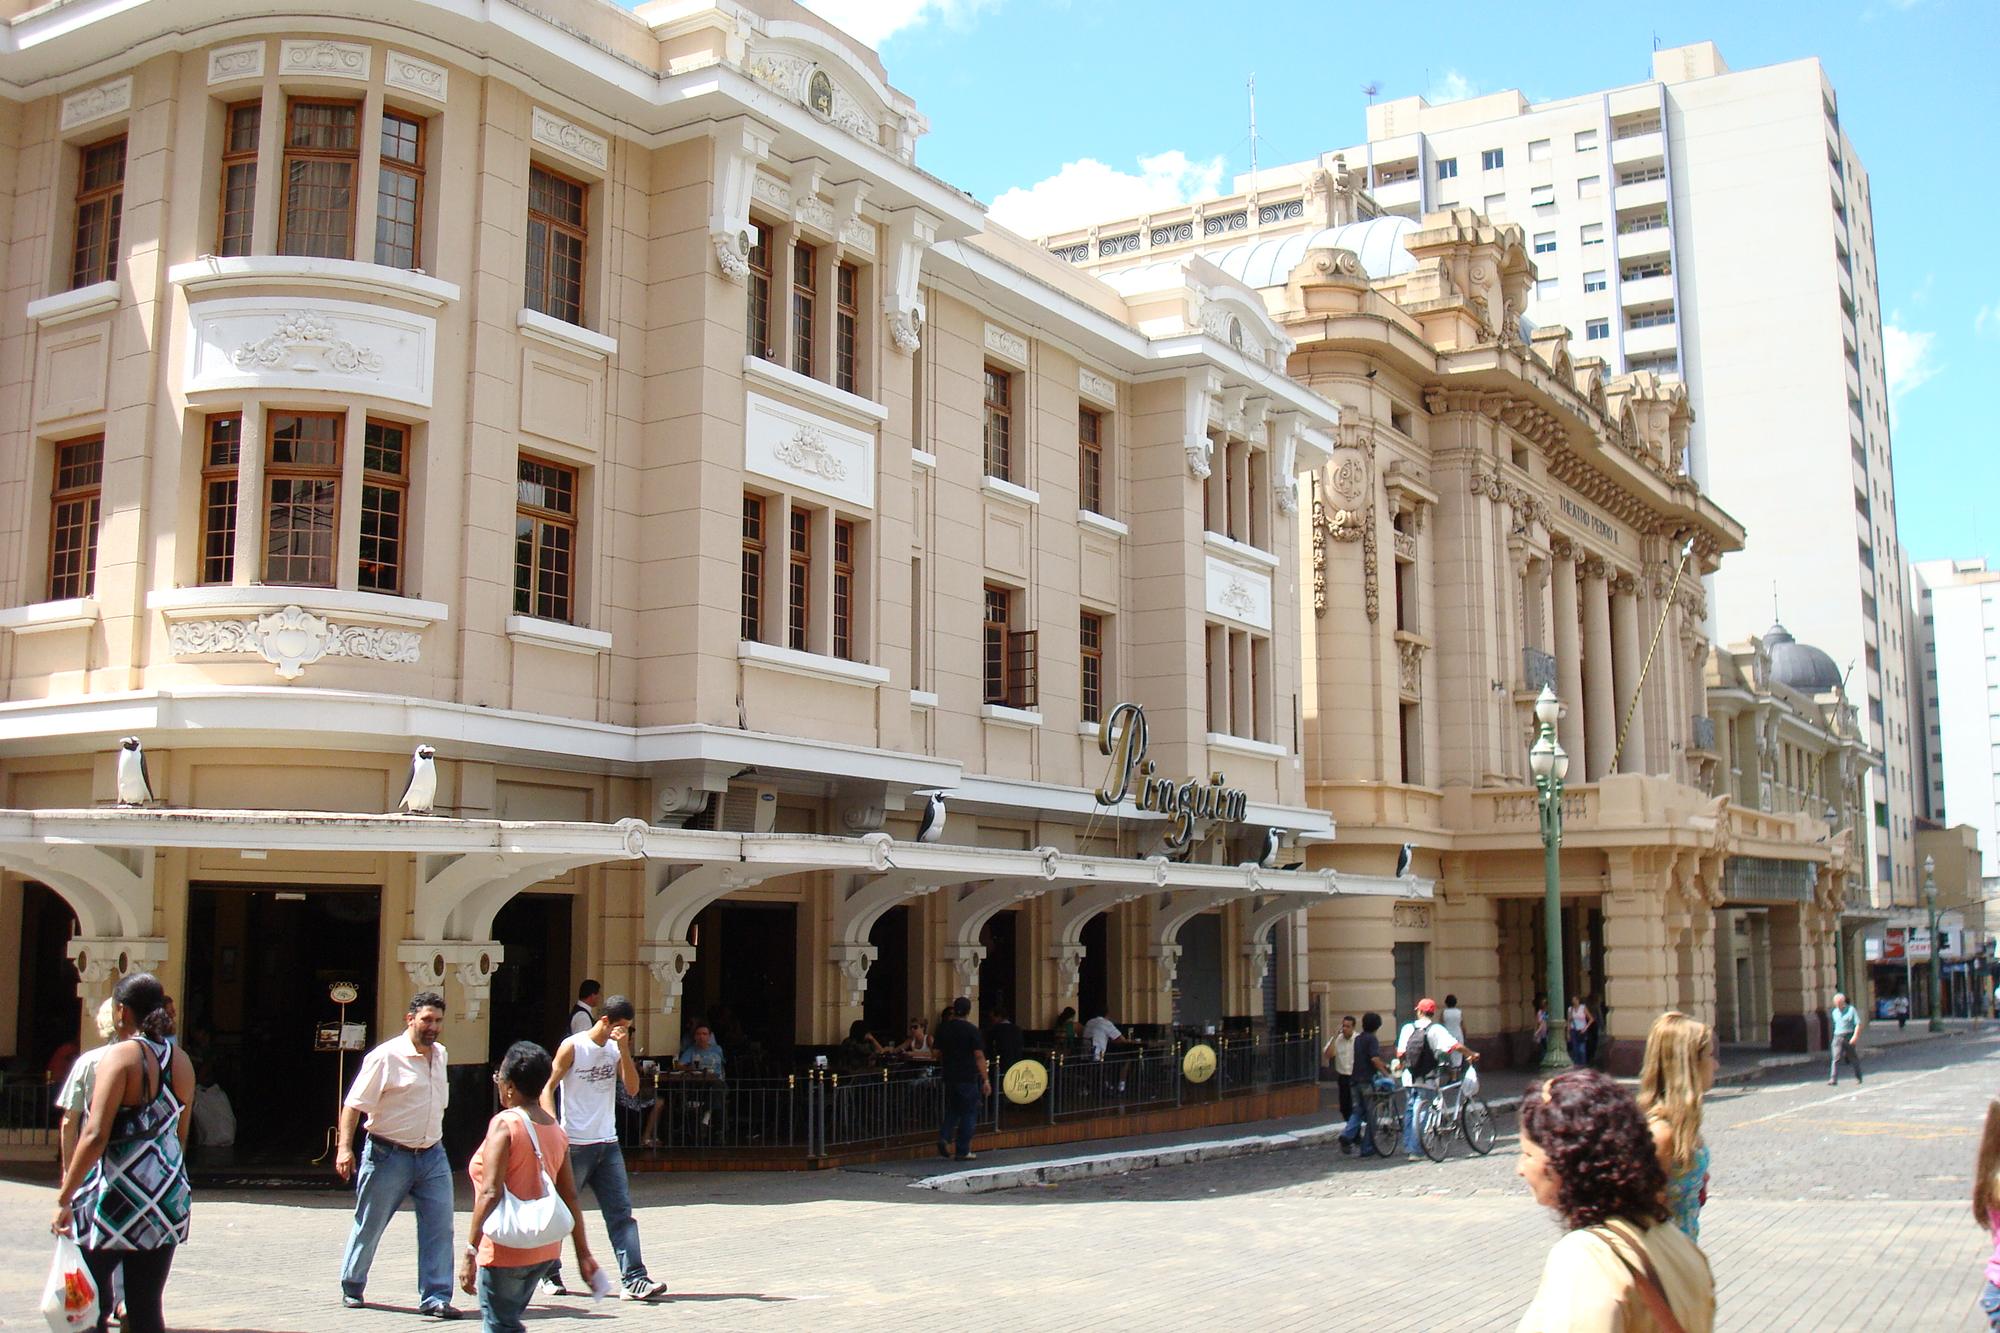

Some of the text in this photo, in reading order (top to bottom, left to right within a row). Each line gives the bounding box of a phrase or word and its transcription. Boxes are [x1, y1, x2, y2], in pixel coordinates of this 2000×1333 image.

[1559, 494, 1590, 528] THEATRO
[1591, 514, 1613, 541] PEDRO
[1096, 702, 1247, 847] Pinguim
